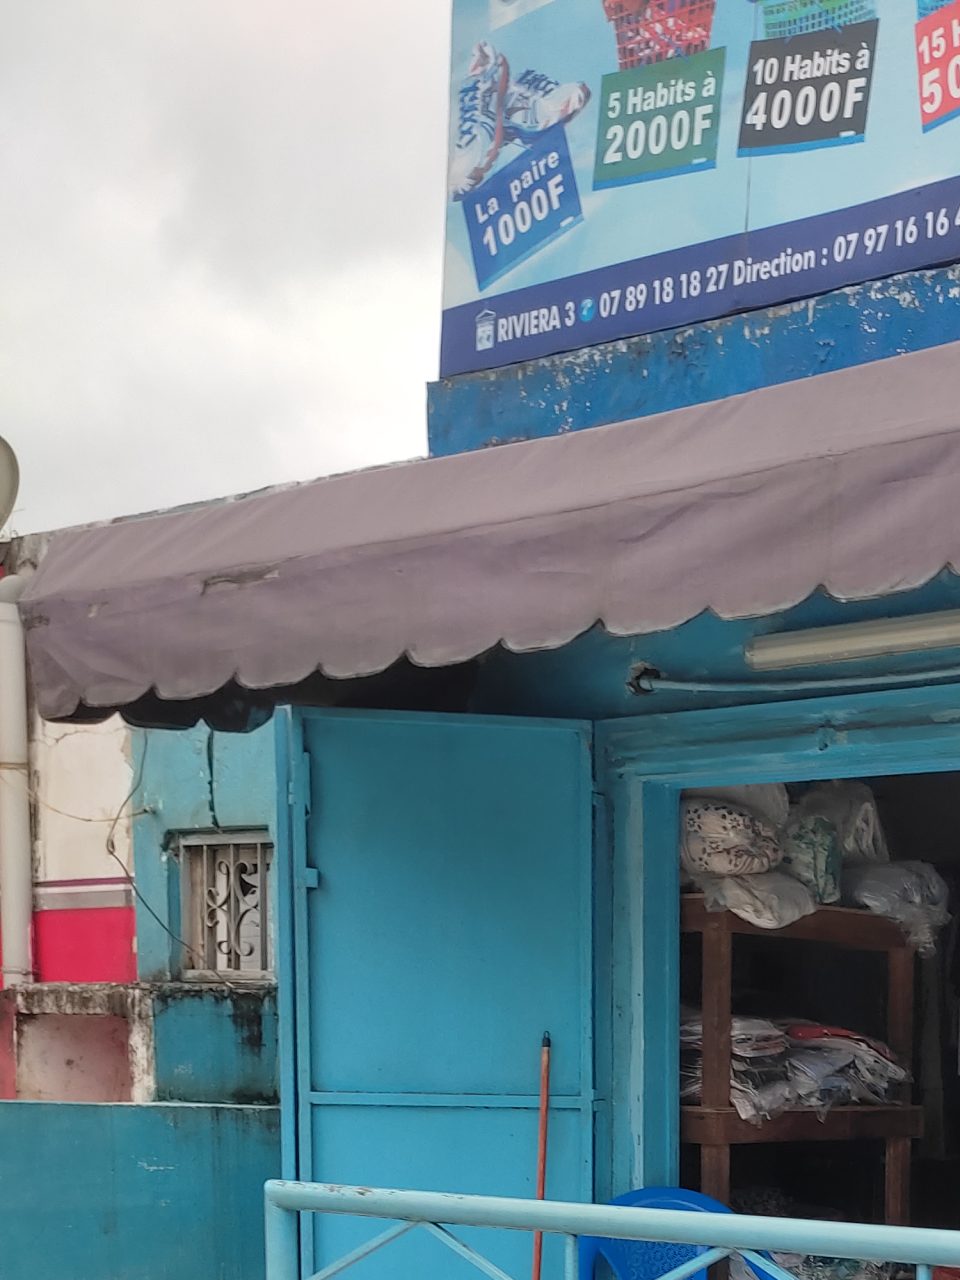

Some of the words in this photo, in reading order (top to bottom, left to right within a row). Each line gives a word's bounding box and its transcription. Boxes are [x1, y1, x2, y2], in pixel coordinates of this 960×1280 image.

[752, 57, 779, 86] 10
[783, 49, 850, 82] Habits
[855, 42, 870, 70] à
[918, 27, 946, 64] 15
[608, 92, 621, 119] 5
[626, 81, 695, 115] Habits
[701, 71, 716, 97] à
[745, 77, 867, 130] 4000F
[603, 105, 714, 164] 2000F
[475, 197, 499, 224] La
[509, 151, 560, 203] paire
[482, 174, 564, 257] 1000F
[497, 305, 561, 342] RIVIERA
[564, 302, 576, 326] 3
[599, 289, 622, 318] 07
[624, 284, 648, 312] 89
[652, 277, 674, 305] 18
[679, 271, 701, 299] 18
[705, 264, 729, 293] 27
[732, 248, 816, 286] Direction
[833, 232, 860, 262] 07
[863, 224, 889, 255] 97
[894, 216, 918, 246] 16
[925, 208, 950, 238] 16
